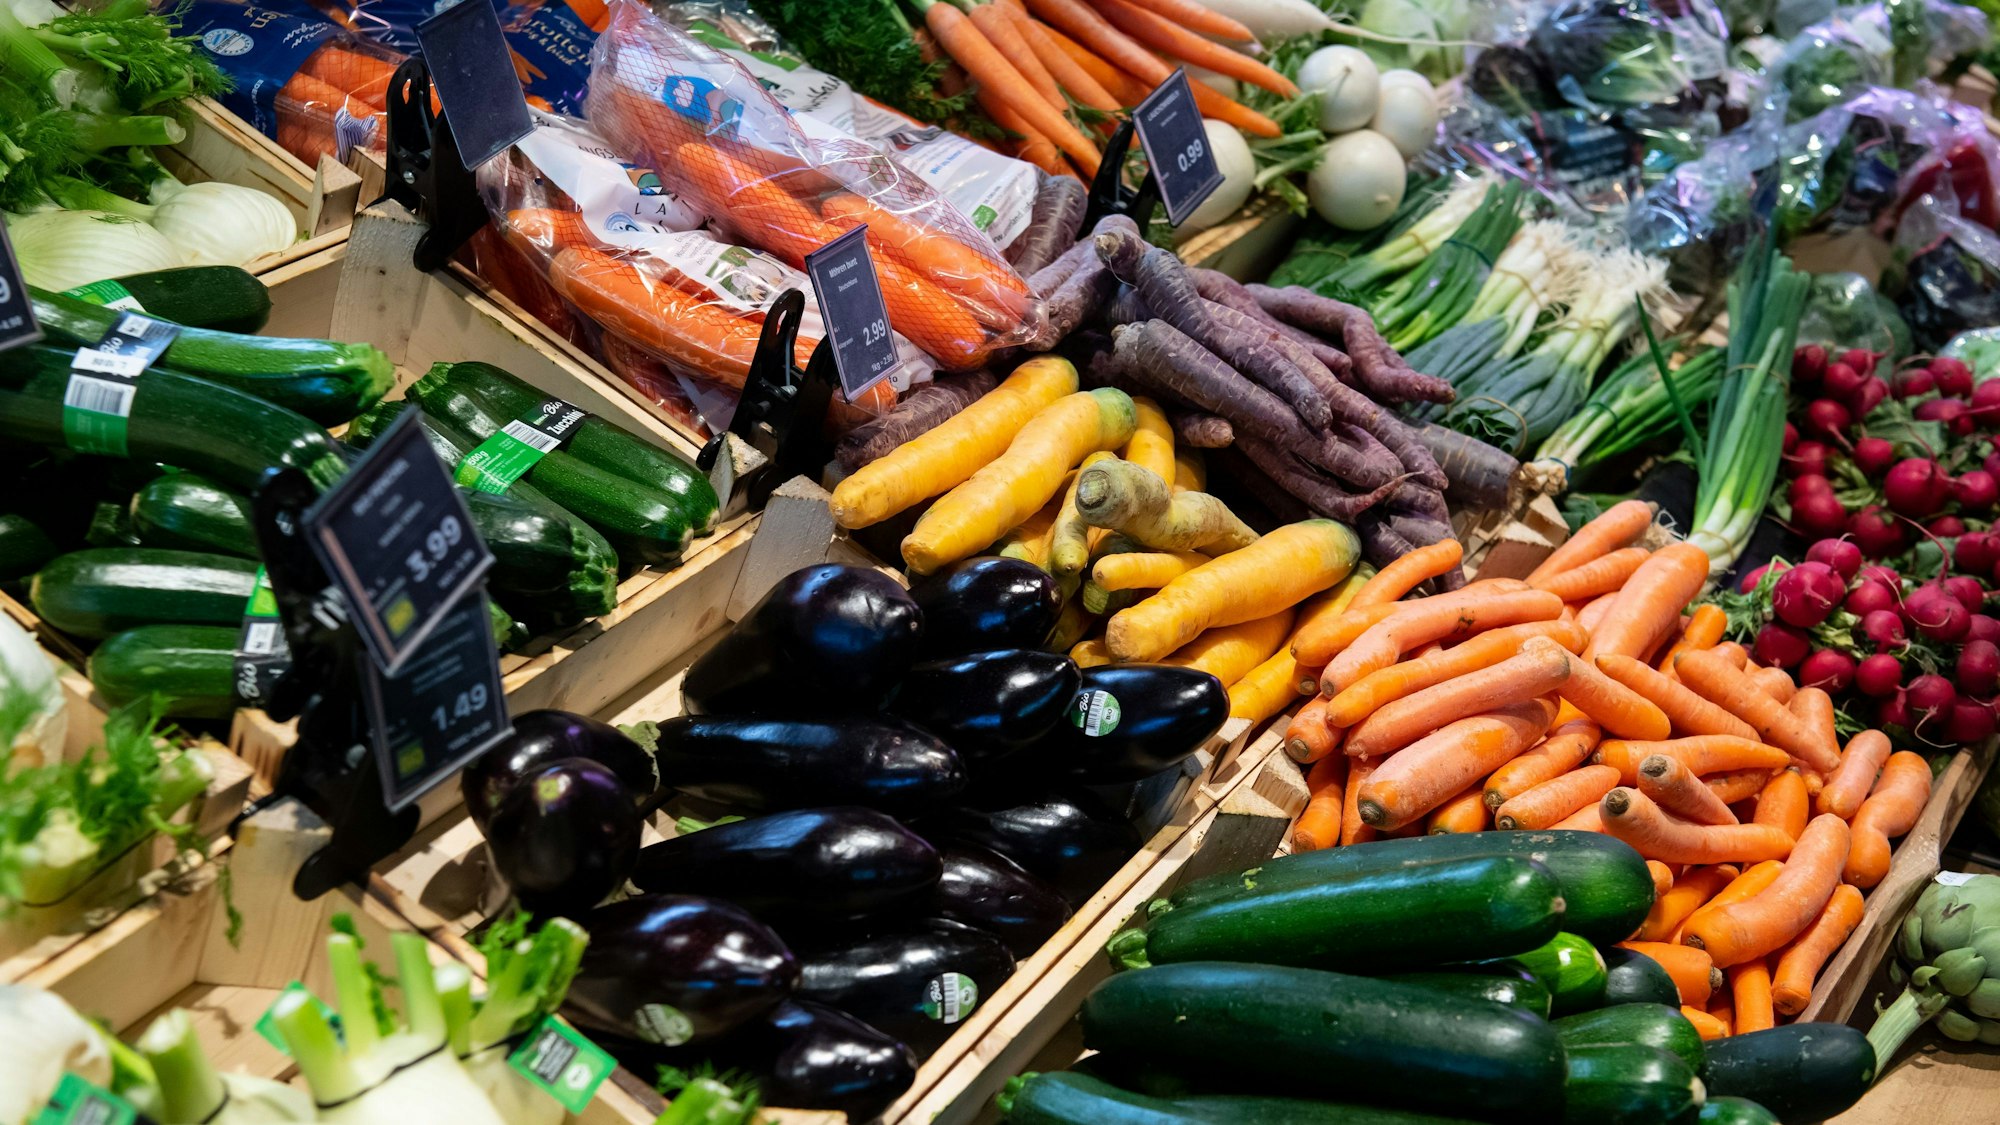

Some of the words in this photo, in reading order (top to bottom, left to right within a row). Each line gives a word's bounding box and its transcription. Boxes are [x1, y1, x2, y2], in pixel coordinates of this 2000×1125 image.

[523, 18, 592, 66] rotten
[1177, 138, 1204, 172] 0.99
[829, 262, 848, 279] Möhren
[845, 257, 858, 271] bunt
[862, 318, 886, 347] 2.99
[883, 353, 894, 366] 2.99
[543, 401, 563, 415] Bio
[546, 409, 586, 435] Zucchini
[405, 515, 462, 583] 3.99
[237, 663, 260, 699] Bio
[431, 682, 488, 731] 1.49
[1079, 692, 1090, 712] Bio
[930, 979, 943, 1003] Bio
